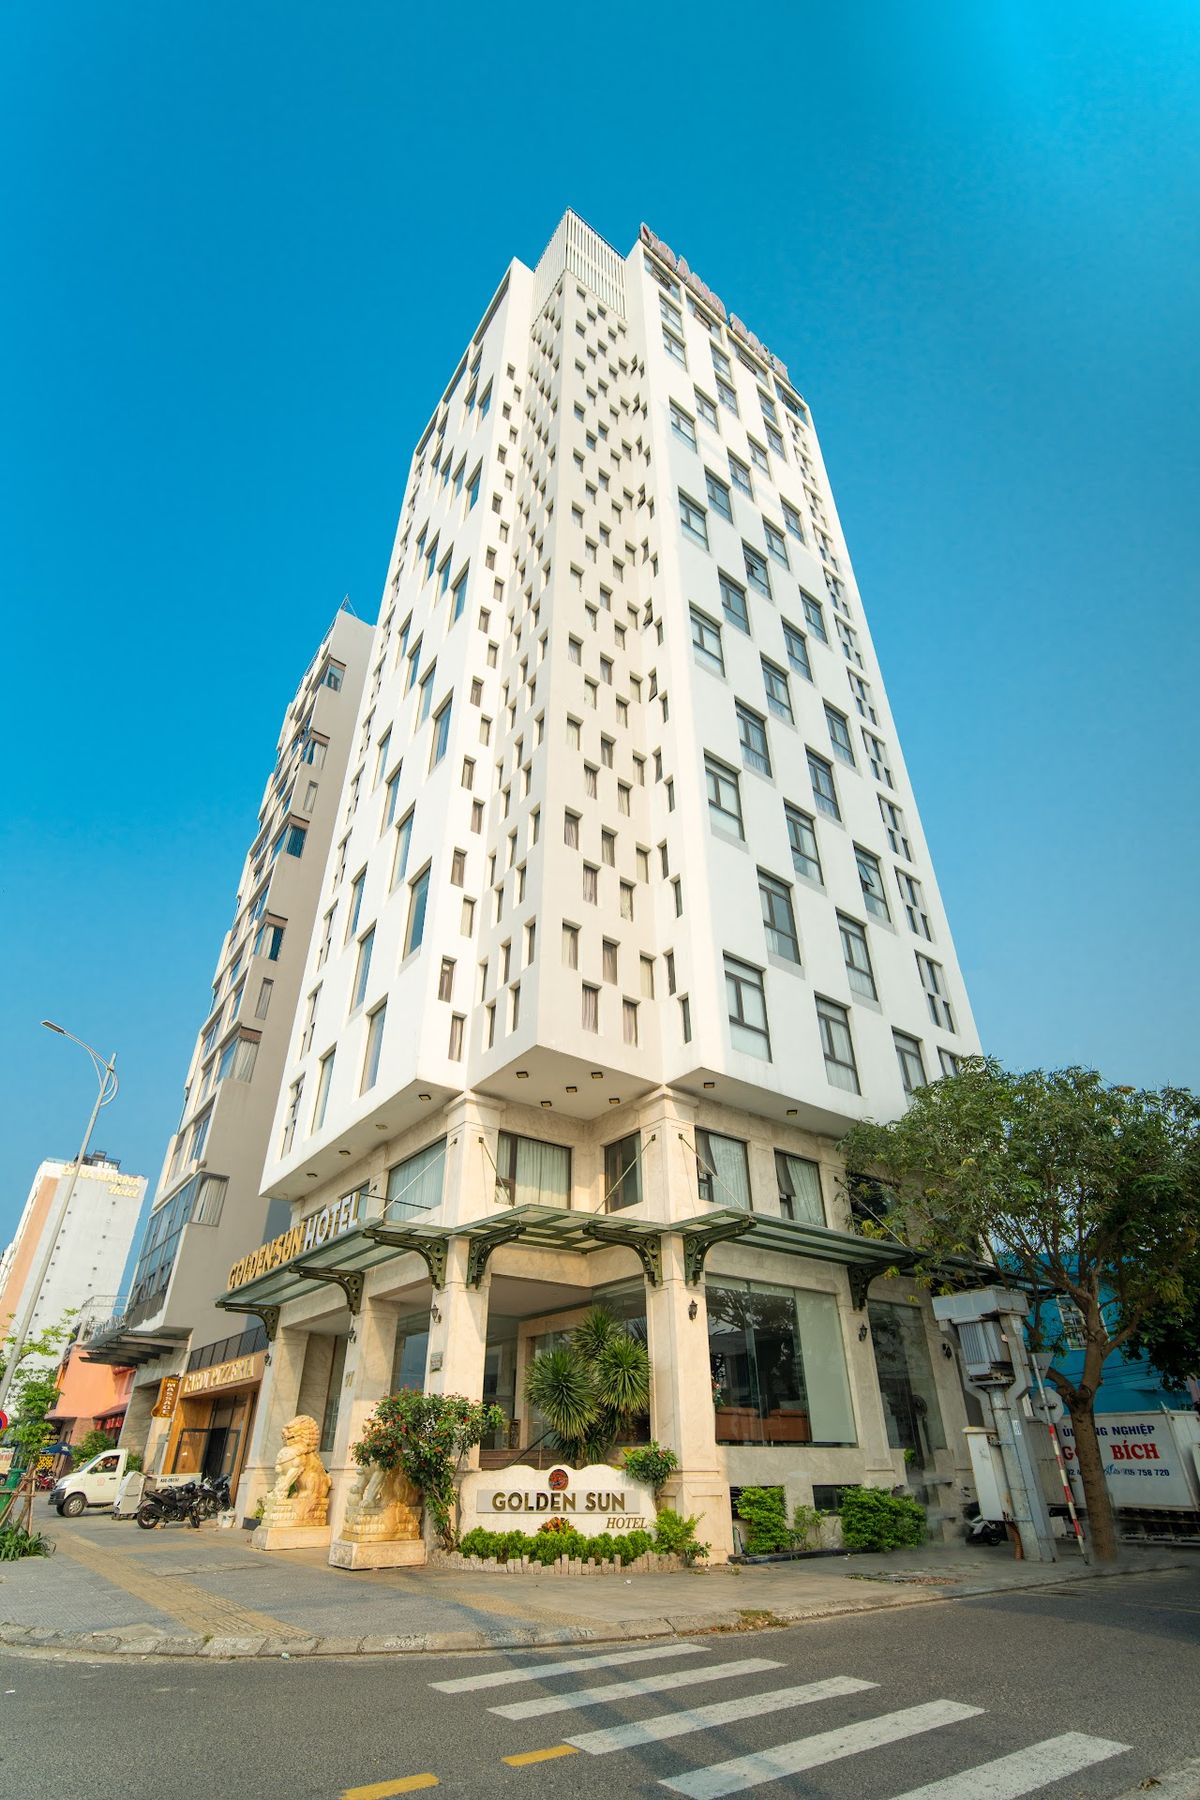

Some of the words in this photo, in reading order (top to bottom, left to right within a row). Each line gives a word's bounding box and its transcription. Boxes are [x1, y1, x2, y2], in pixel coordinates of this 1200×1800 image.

[95, 1171, 141, 1187] MARINA
[227, 1239, 275, 1291] GOLDEN
[273, 1221, 306, 1264] SUN
[303, 1191, 359, 1252] HOTEL
[163, 1382, 176, 1414] MASSAGE
[1112, 1423, 1155, 1437] NGHIỆP
[1110, 1440, 1160, 1460] BÍCH
[492, 1491, 576, 1511] GOLDEN
[585, 1491, 625, 1511] SUN
[606, 1517, 648, 1529] HOTEL
